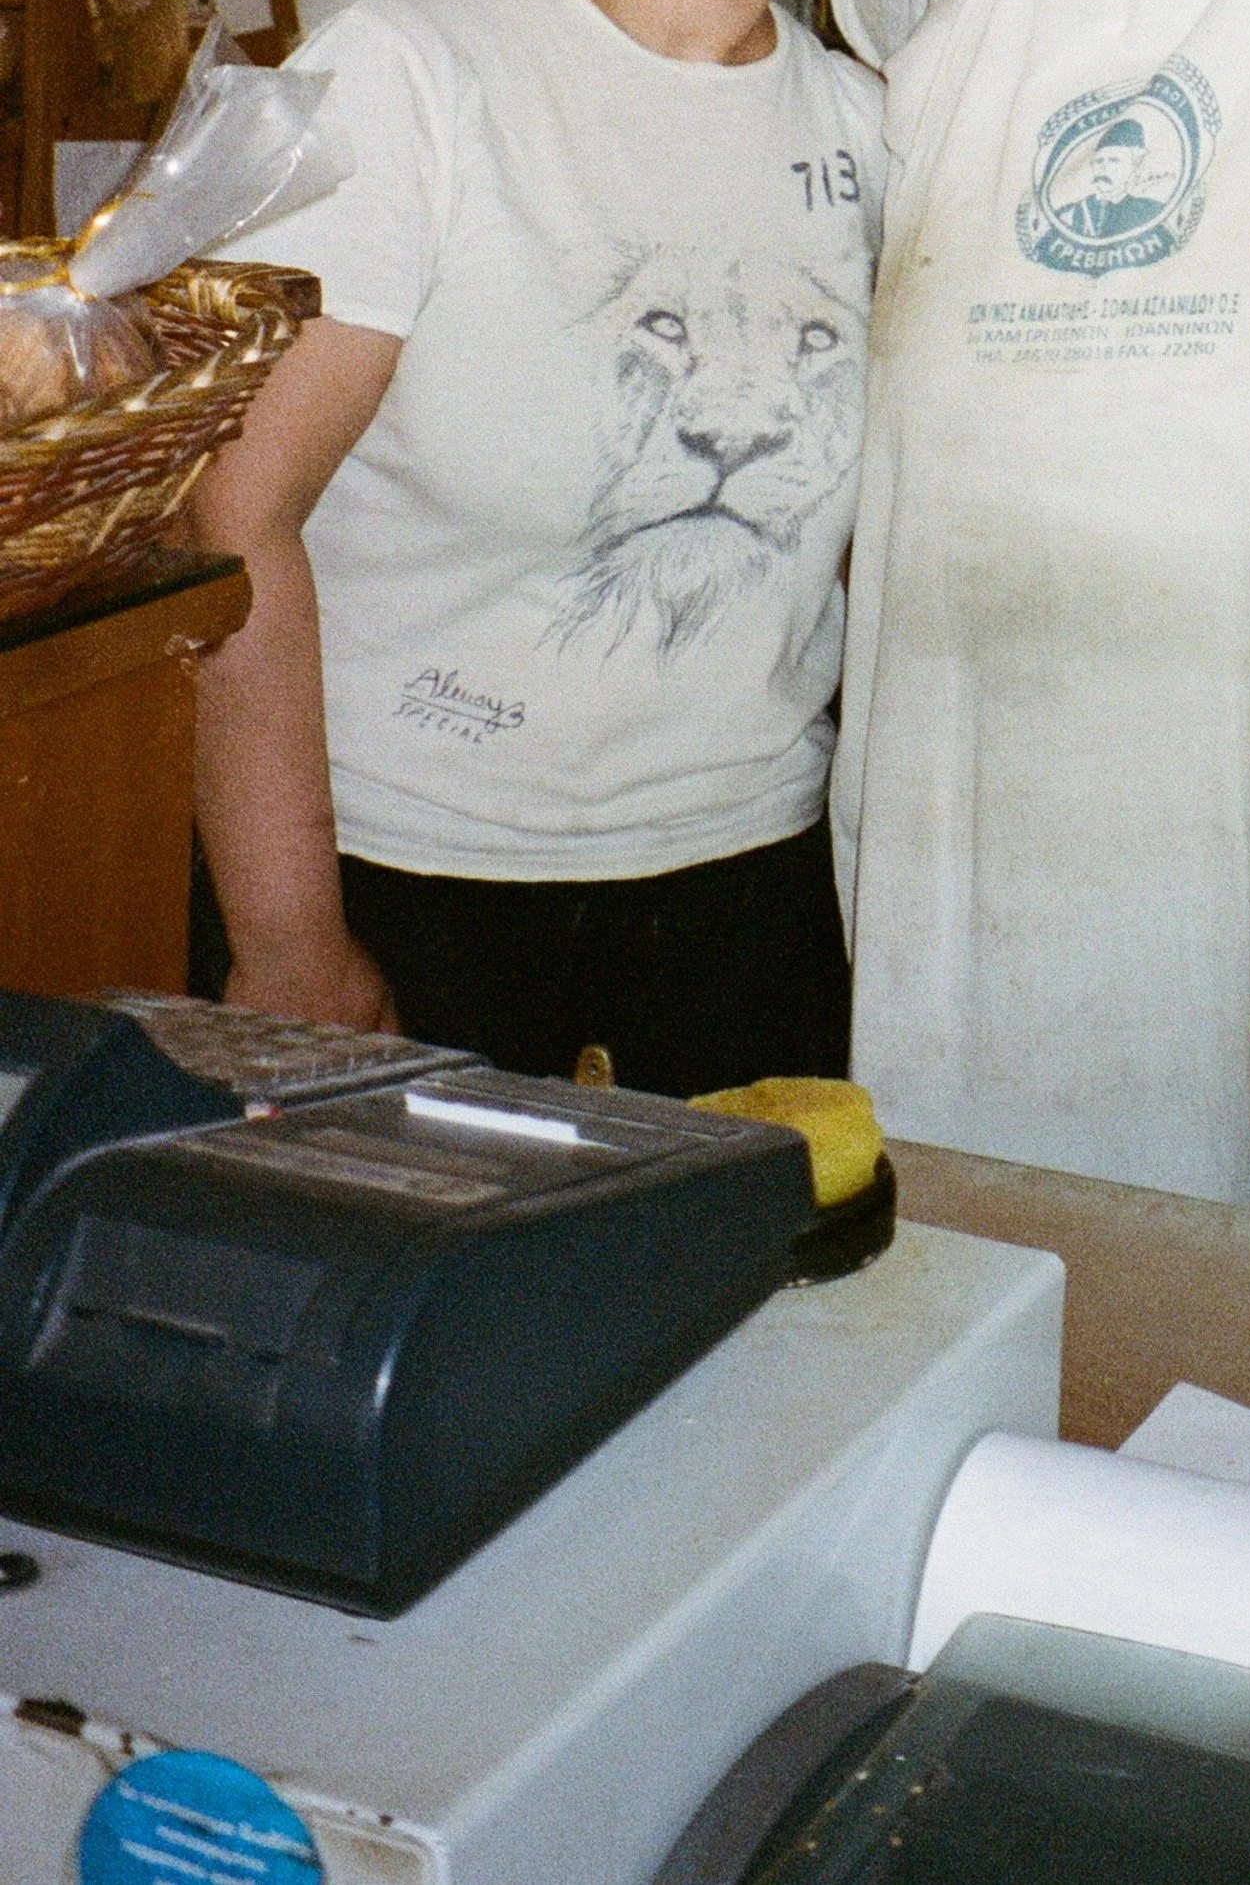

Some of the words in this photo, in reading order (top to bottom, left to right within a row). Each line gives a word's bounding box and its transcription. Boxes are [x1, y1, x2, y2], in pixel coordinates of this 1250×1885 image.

[792, 149, 862, 211] 713
[1050, 235, 1165, 269] ΓΡΕΒΕΝΩΝ
[1124, 319, 1234, 340] ΙΩΑΝΝΙΝΩΝ
